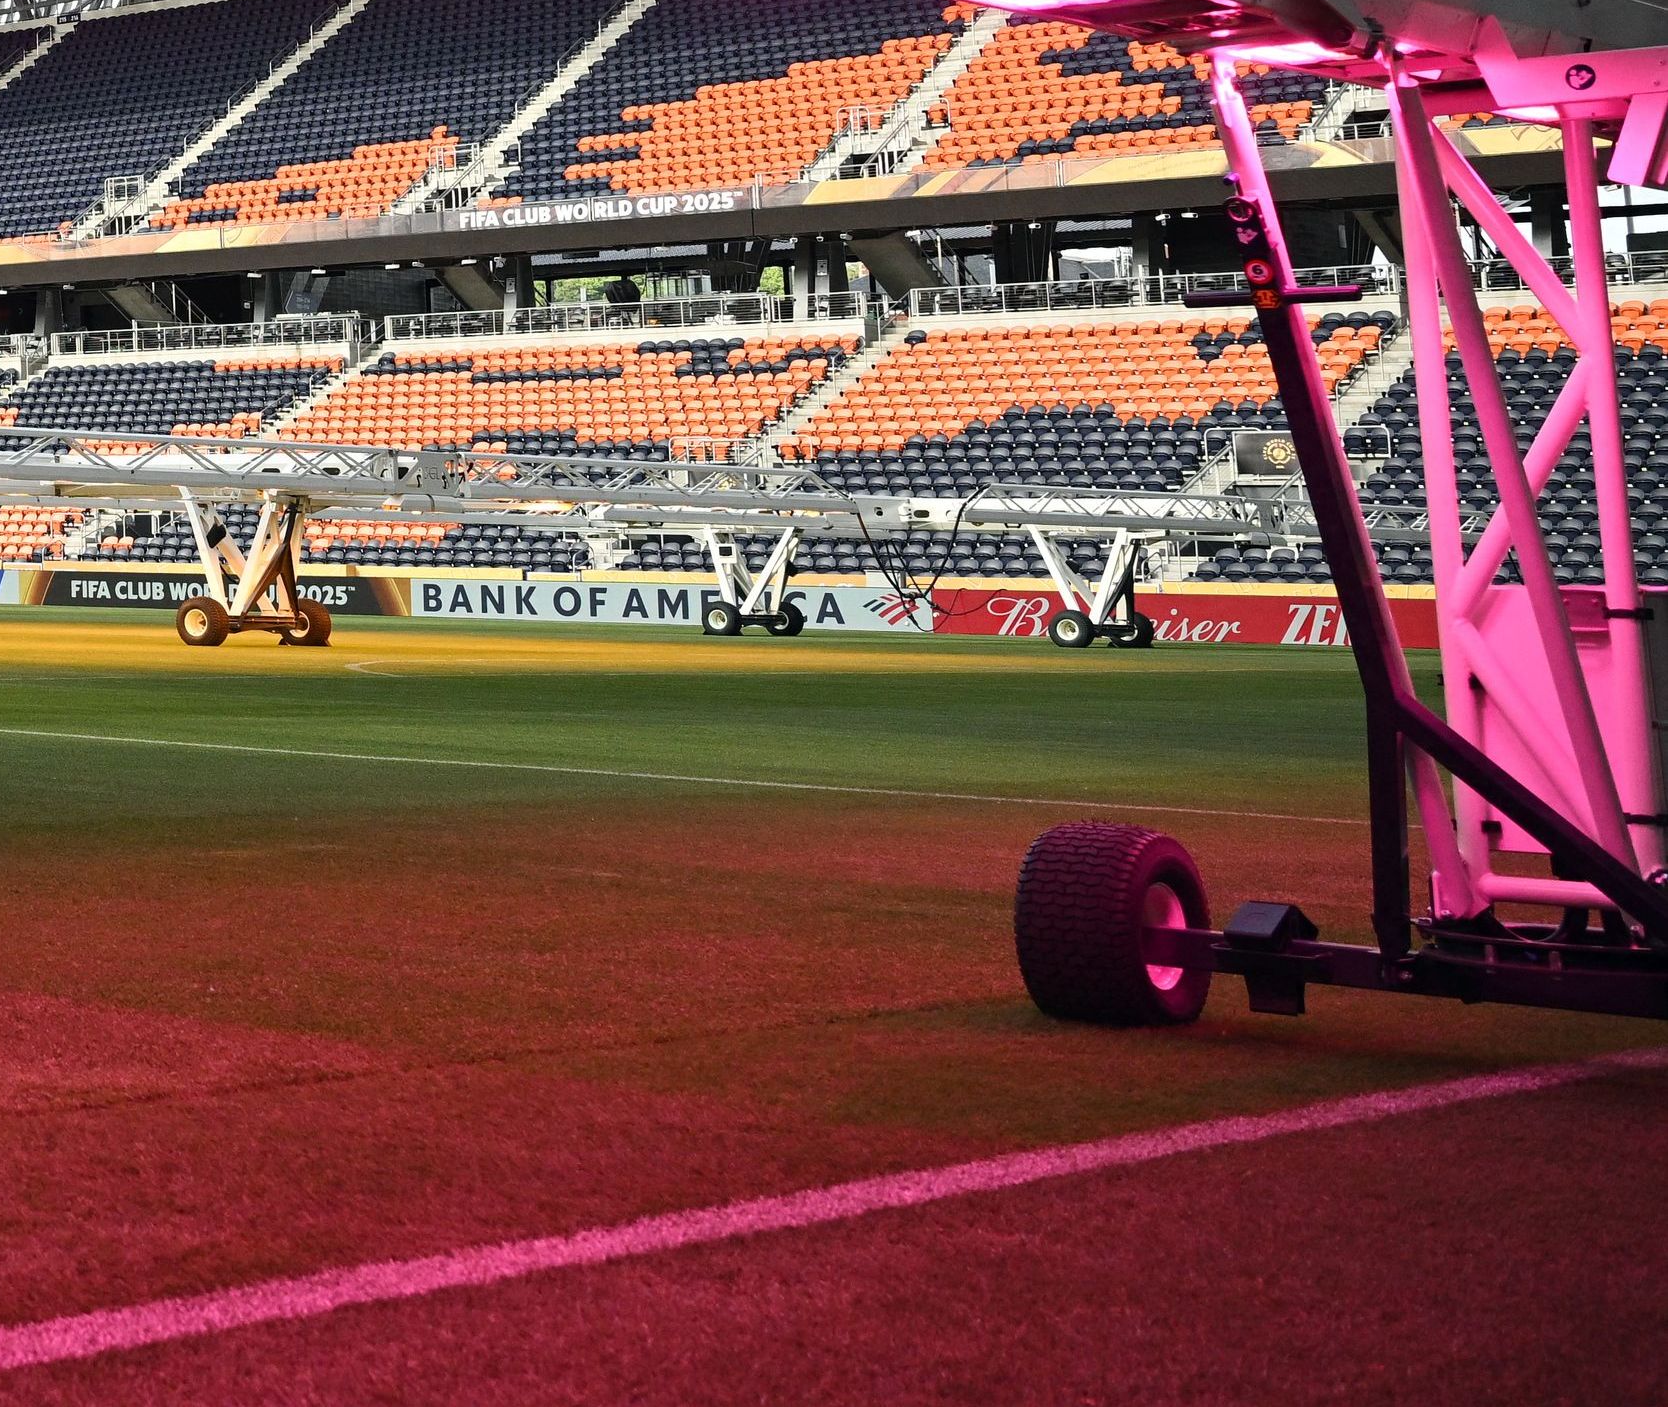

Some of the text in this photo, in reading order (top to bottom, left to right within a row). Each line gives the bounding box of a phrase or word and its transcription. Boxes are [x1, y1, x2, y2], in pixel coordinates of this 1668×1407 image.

[459, 208, 499, 229] FIFA
[502, 203, 551, 226] CLUB
[554, 197, 633, 222] WORLD
[636, 195, 675, 216] CUP
[71, 580, 110, 599] FIFA
[115, 581, 164, 600] CLUB
[422, 583, 538, 616] BANK
[553, 586, 608, 617] OF
[1280, 604, 1353, 647] ZE
